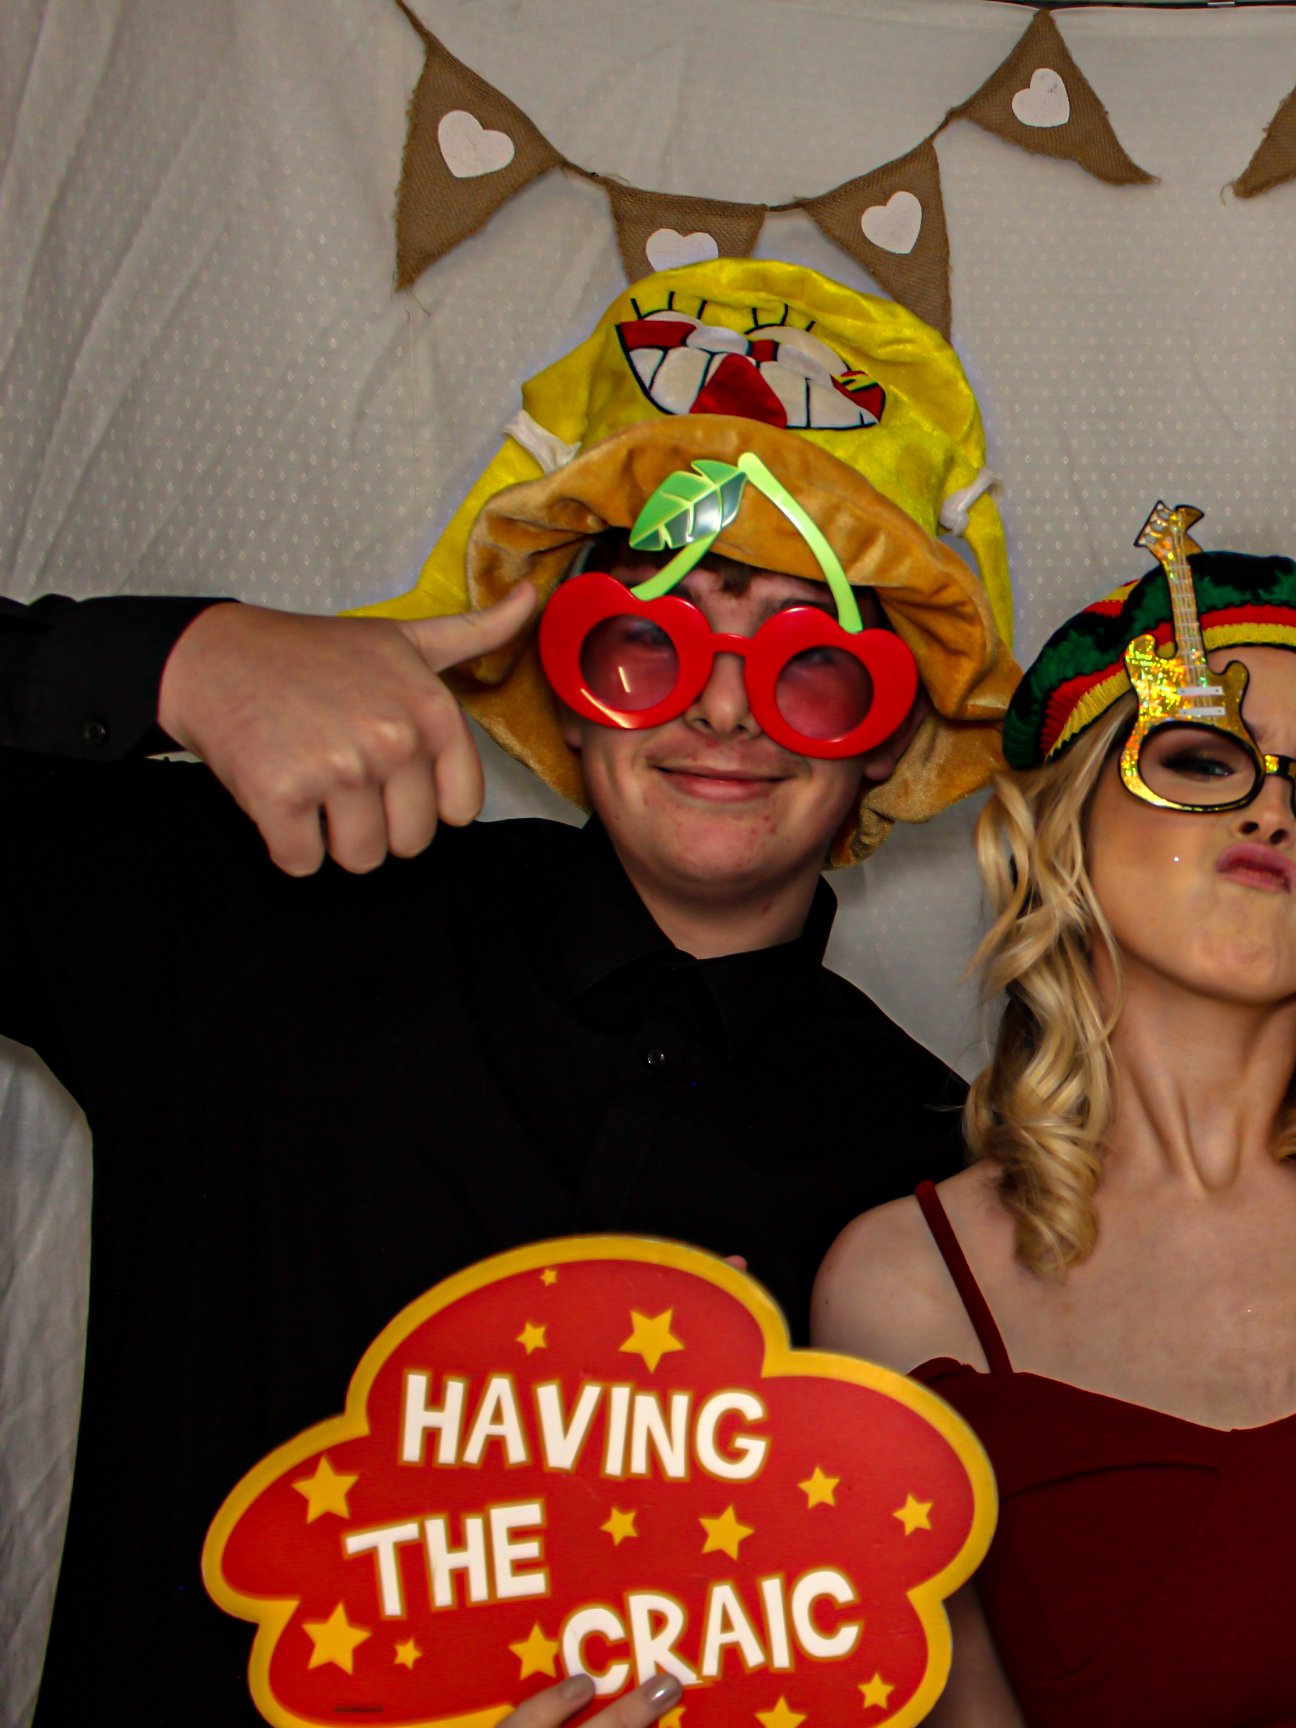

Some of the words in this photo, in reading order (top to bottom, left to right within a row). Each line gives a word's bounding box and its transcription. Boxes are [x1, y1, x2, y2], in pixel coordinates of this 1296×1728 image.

[402, 1373, 767, 1480] HAVING
[345, 1503, 547, 1617] THE
[562, 1569, 860, 1695] CRAIC
